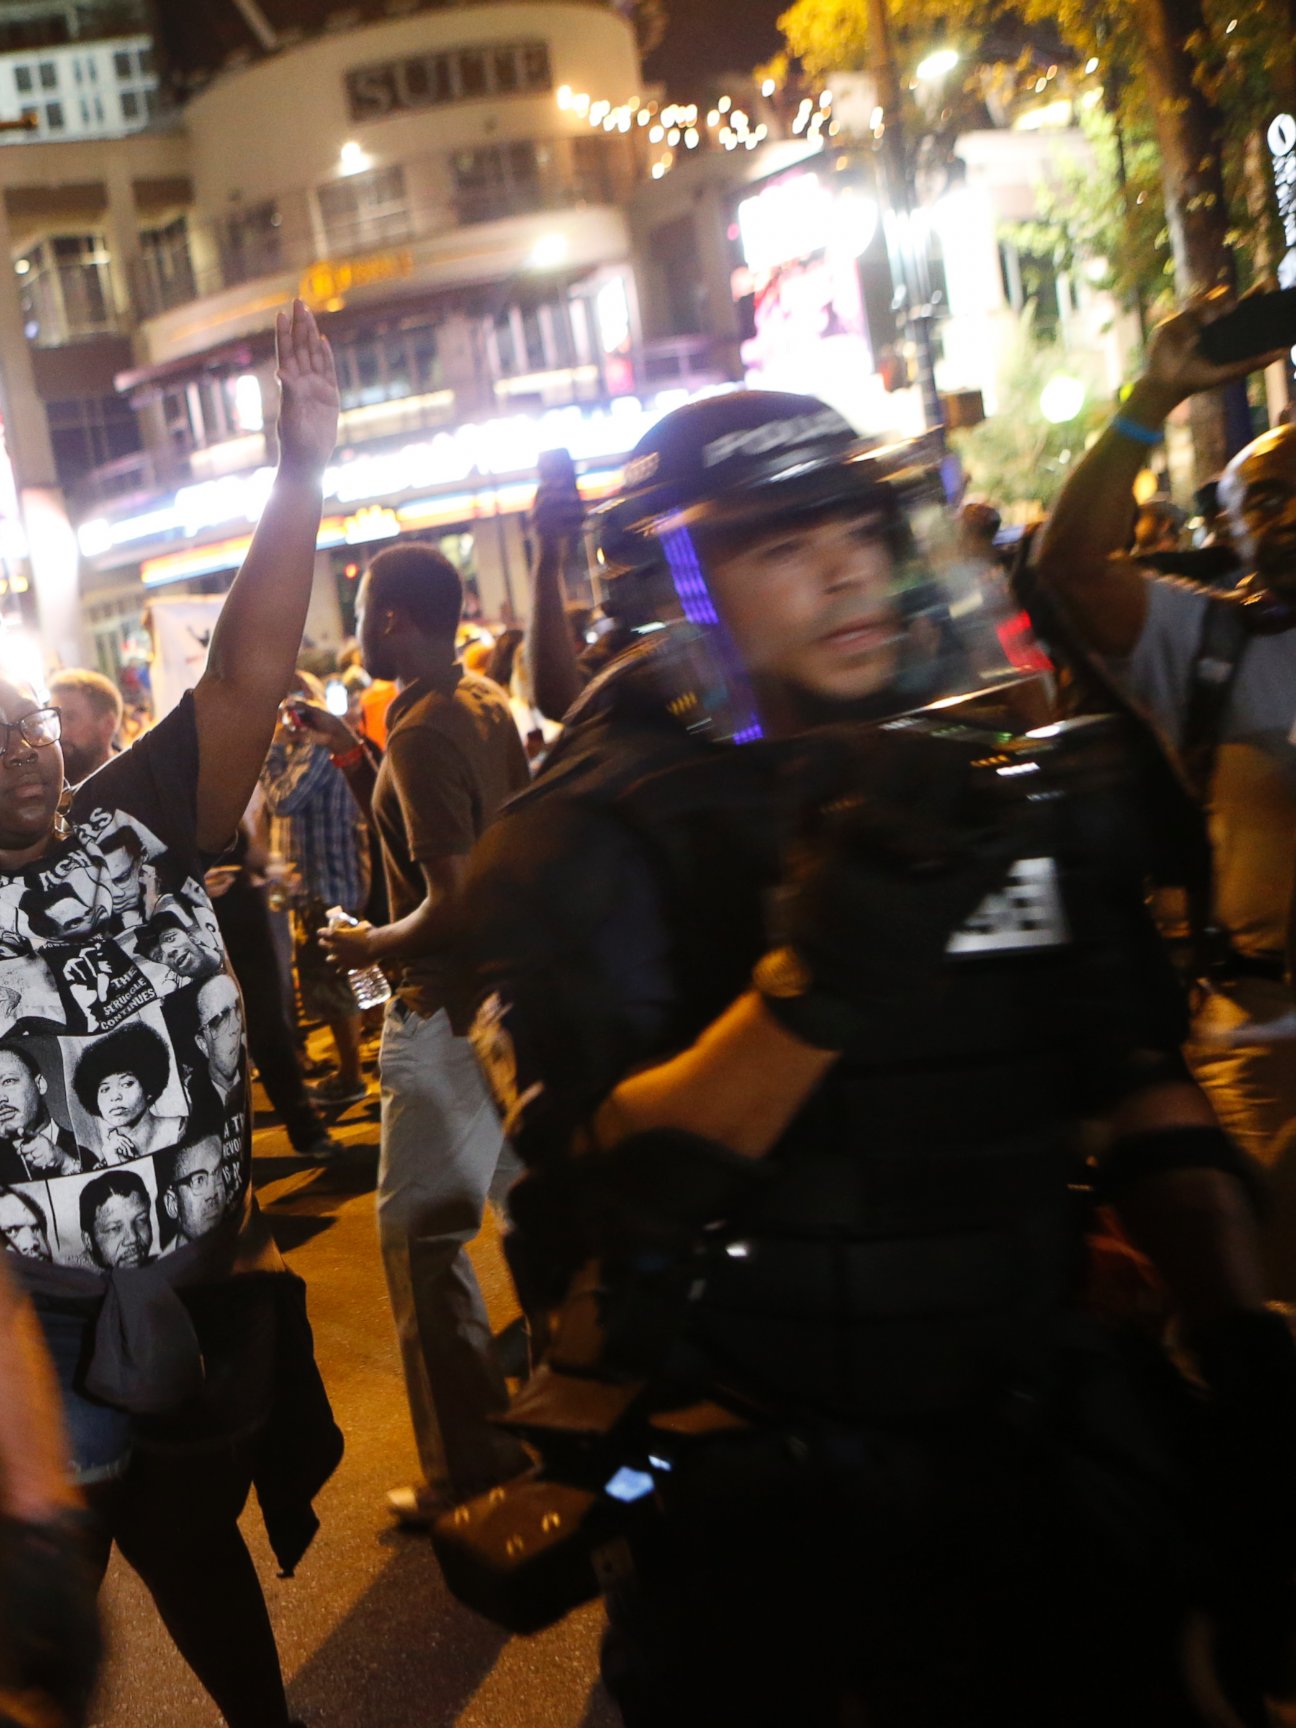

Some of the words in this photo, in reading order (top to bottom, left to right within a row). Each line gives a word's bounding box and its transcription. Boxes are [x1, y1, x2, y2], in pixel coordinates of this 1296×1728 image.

[104, 977, 147, 1016] STRUGGLE
[111, 966, 138, 990] THE
[101, 988, 156, 1031] CONTINUES
